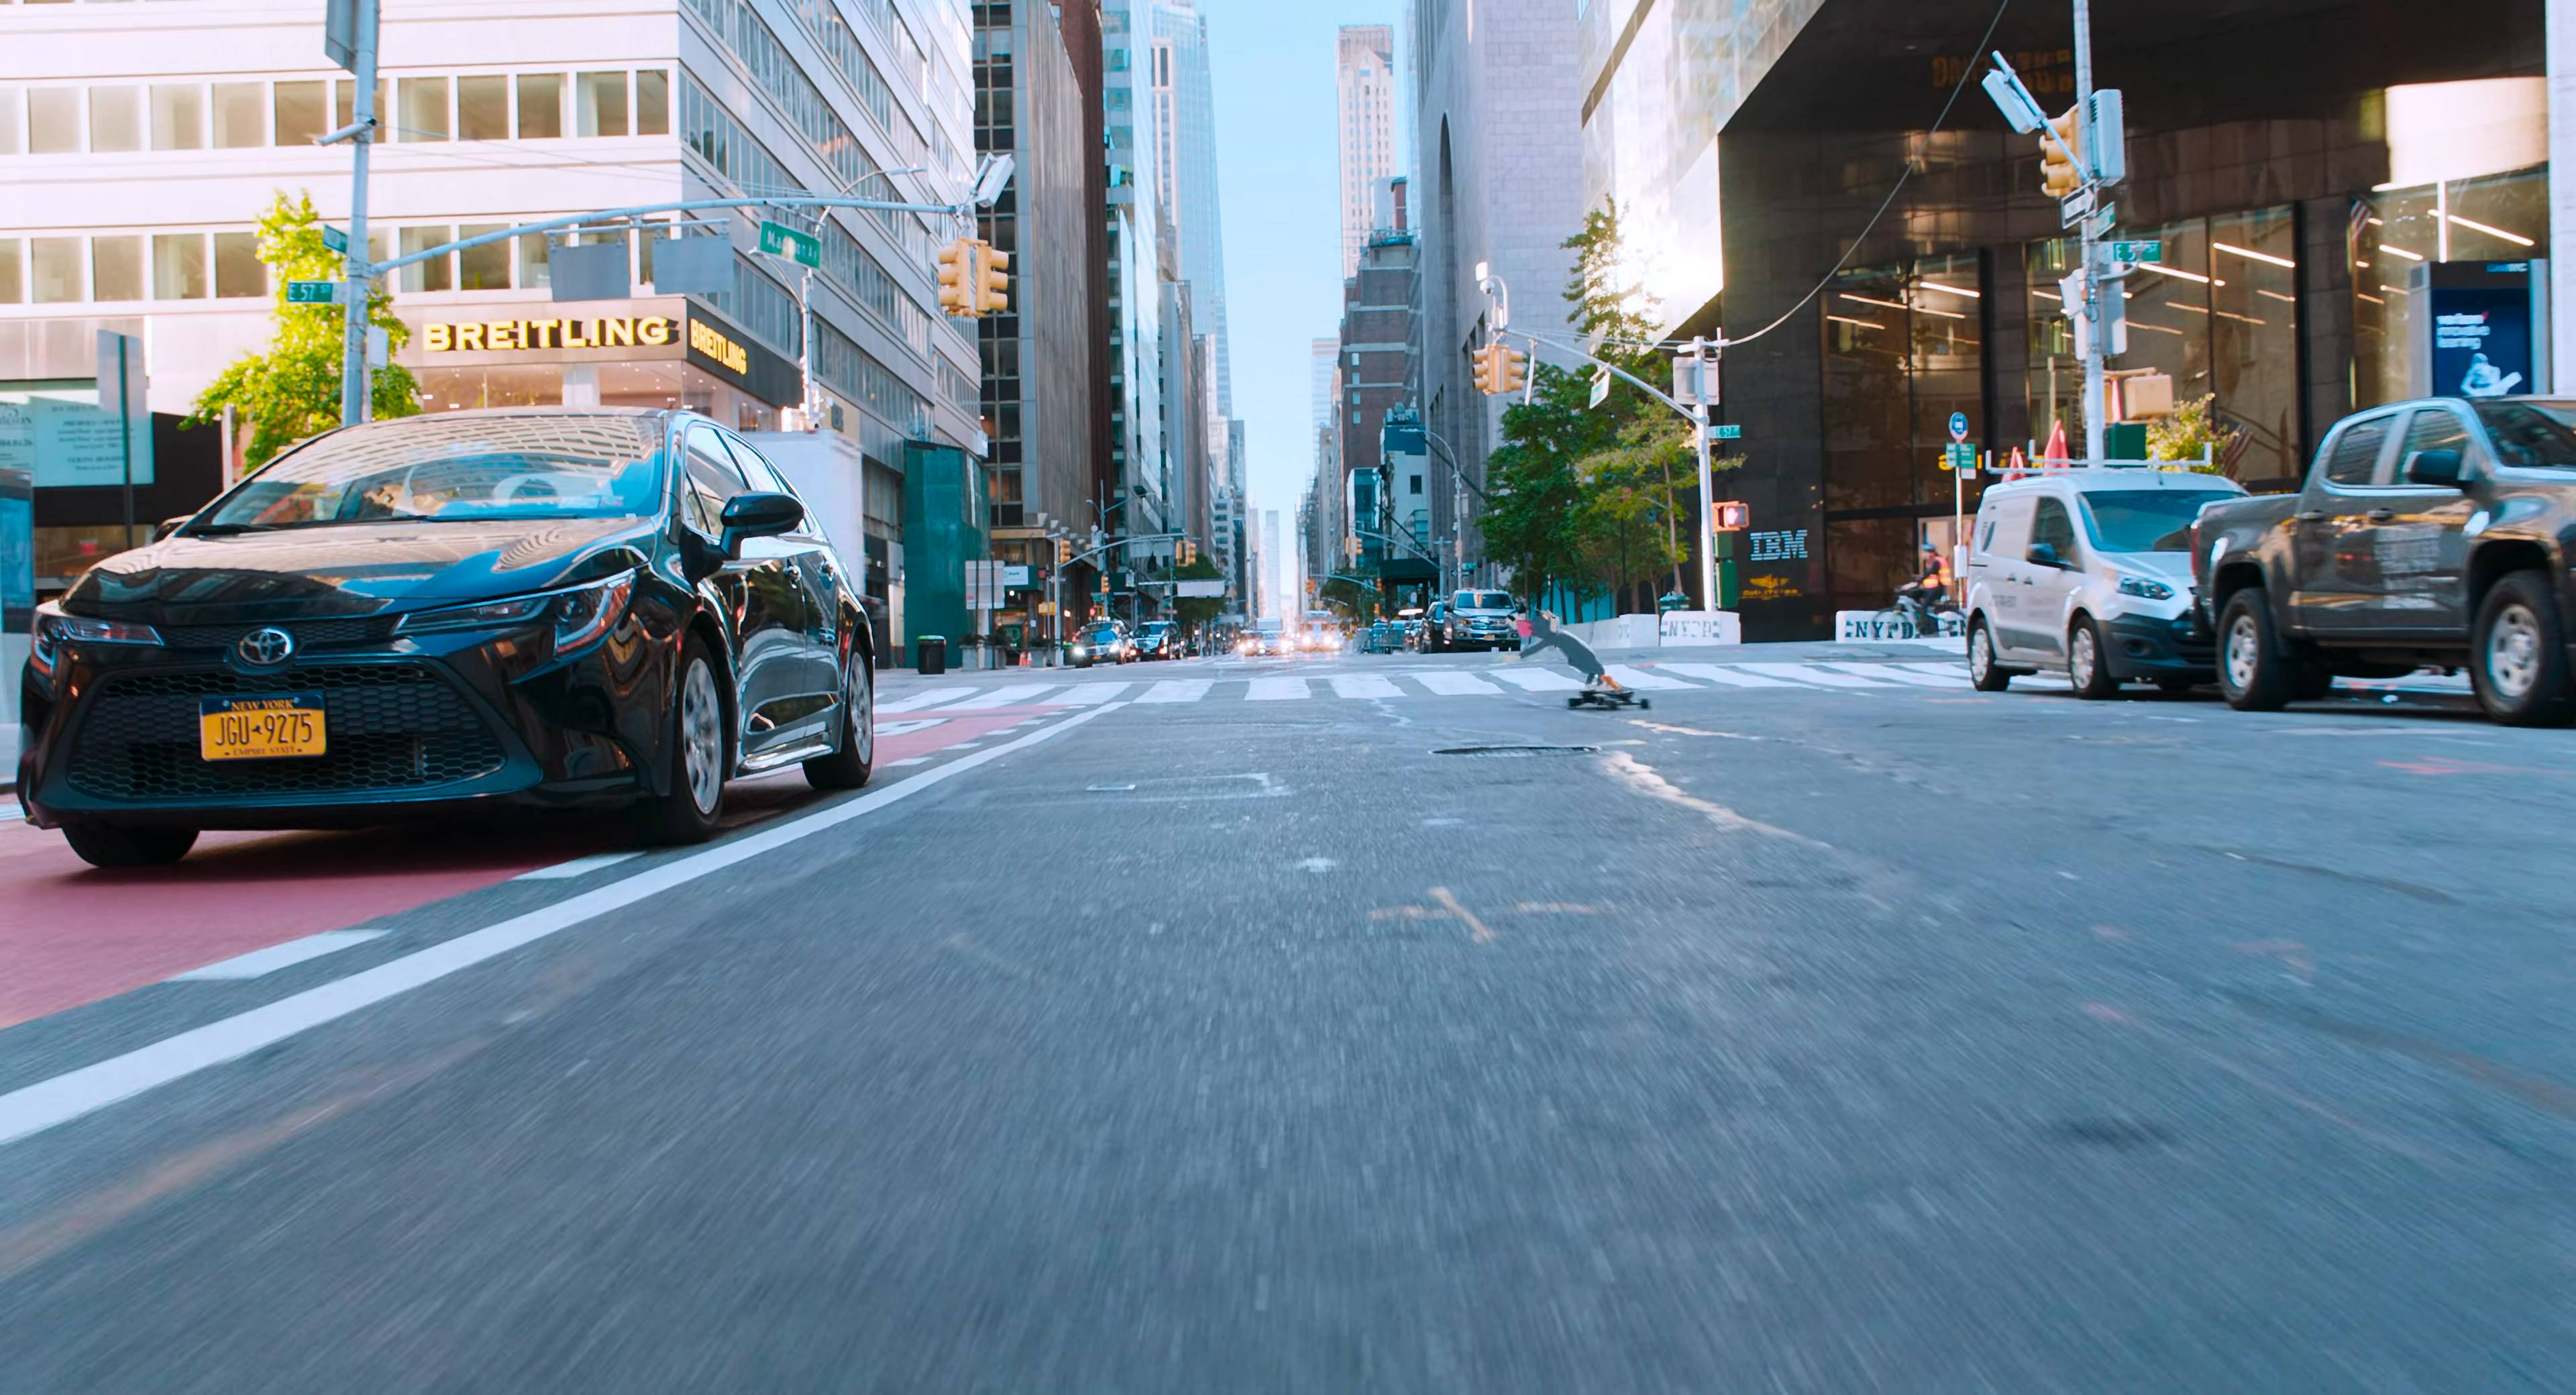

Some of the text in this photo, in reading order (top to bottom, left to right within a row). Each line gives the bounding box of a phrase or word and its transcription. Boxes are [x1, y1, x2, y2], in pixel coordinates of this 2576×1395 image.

[767, 230, 806, 258] Maon
[288, 284, 331, 300] E 57 ST
[422, 316, 670, 351] BREITLING
[690, 318, 748, 376] BREITLING
[1750, 529, 1808, 561] IBM
[1856, 621, 1913, 638] NYPD
[231, 699, 295, 711] NEW YORK
[233, 746, 295, 755] EMPIRE STATE
